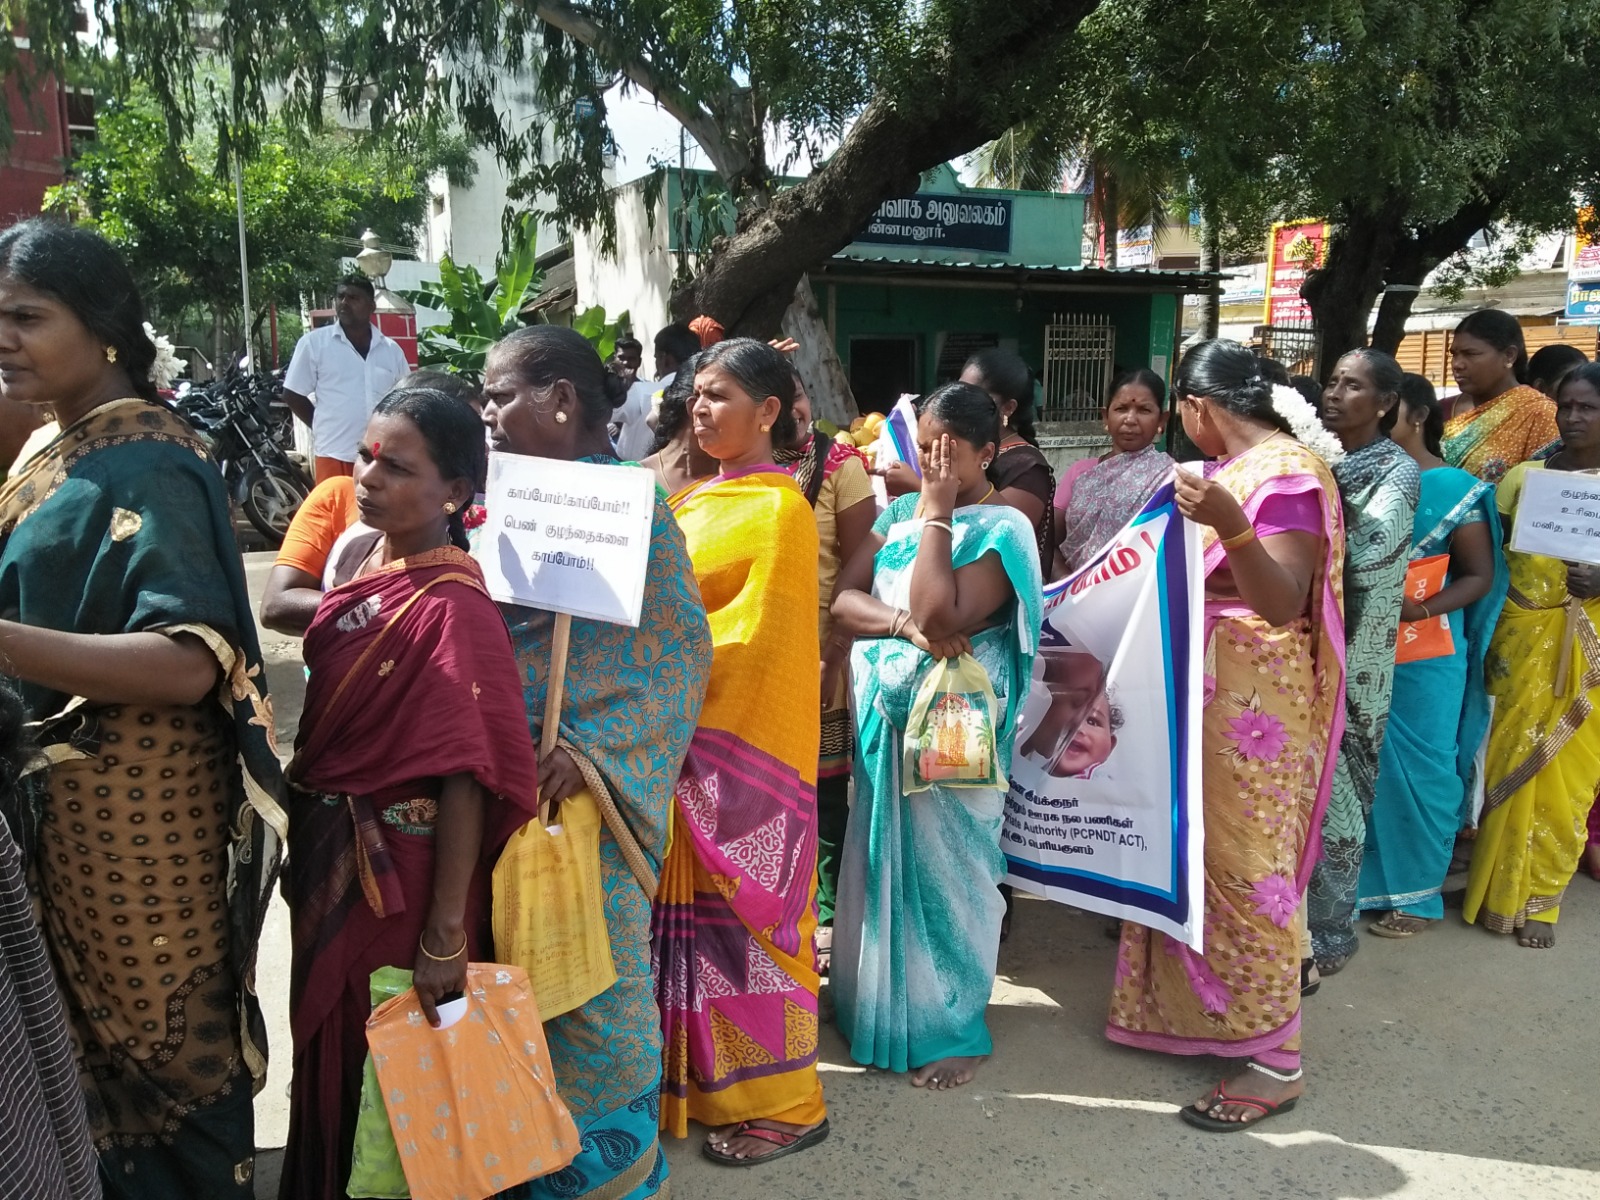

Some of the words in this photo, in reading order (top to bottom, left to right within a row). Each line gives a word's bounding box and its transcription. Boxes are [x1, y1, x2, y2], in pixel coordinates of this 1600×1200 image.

[925, 199, 1006, 227] அலுவலகம்
[504, 515, 537, 532] பெண்
[545, 525, 630, 548] குழந்தைகளை
[1532, 521, 1563, 533] மனித
[531, 550, 595, 571] காப்போம்!!
[1027, 808, 1060, 822] ஊரக
[1062, 814, 1082, 825] நல
[1084, 815, 1134, 829] பணிகள்
[1024, 820, 1067, 840] Authority
[1070, 827, 1117, 844] (PCPNDT
[1118, 834, 1148, 852] ACT),
[1028, 838, 1094, 856] பெரியகுளம்
